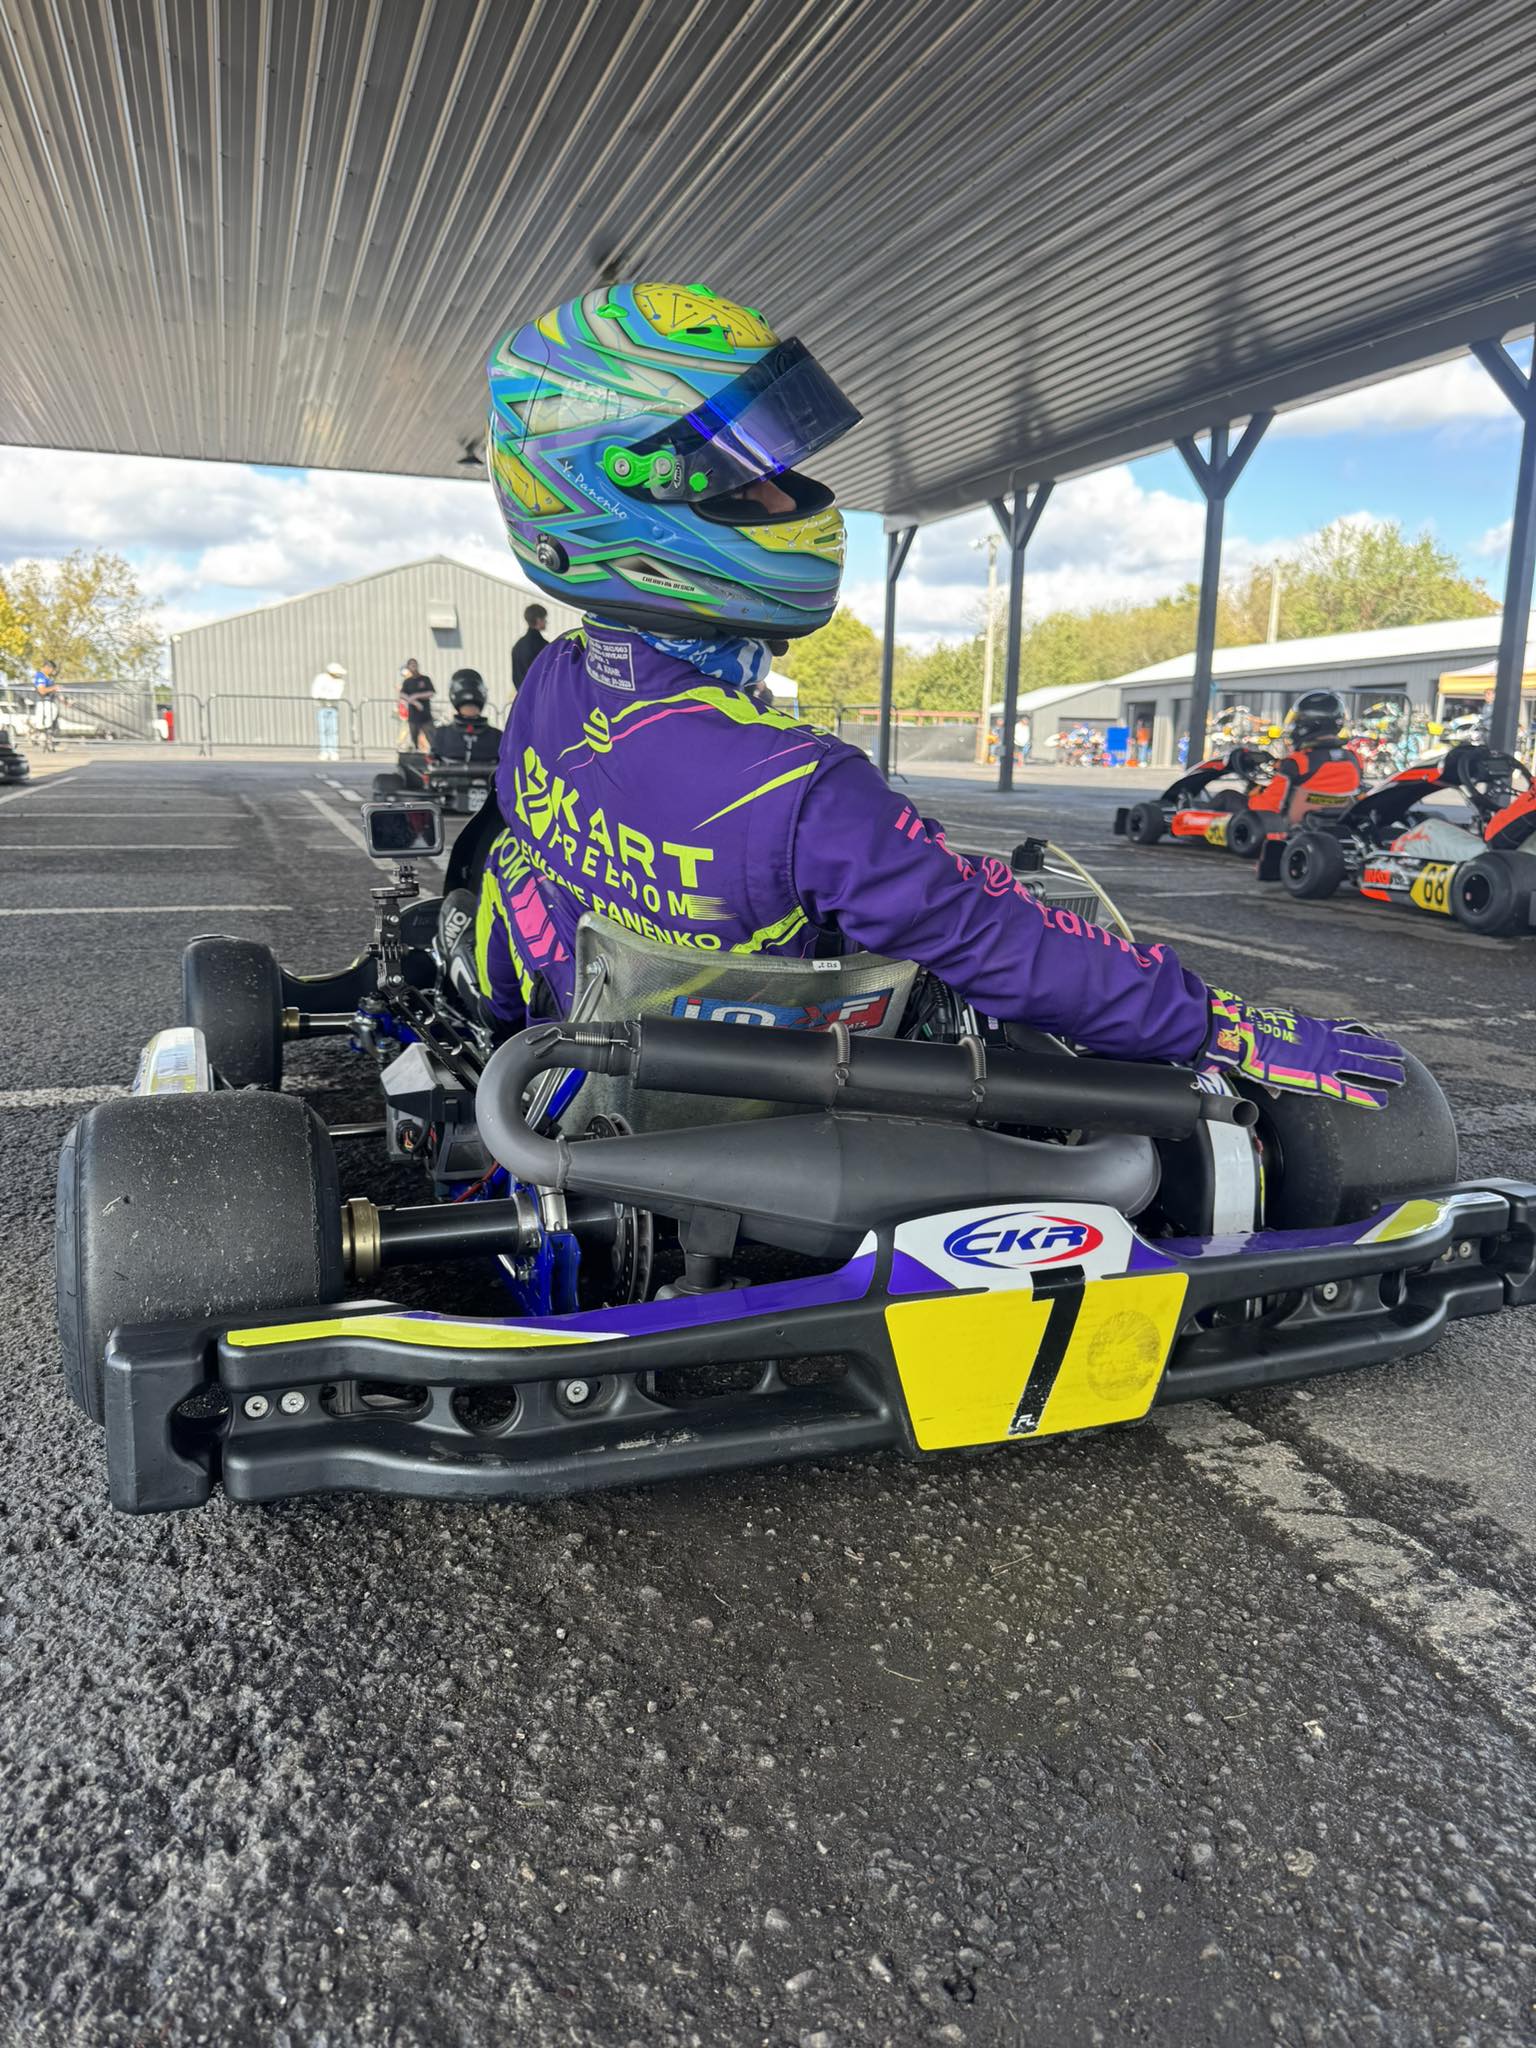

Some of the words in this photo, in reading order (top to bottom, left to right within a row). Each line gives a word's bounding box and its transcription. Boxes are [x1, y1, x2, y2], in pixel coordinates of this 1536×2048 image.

[575, 473, 627, 519] Panenko
[673, 583, 695, 592] DESIGN
[551, 776, 714, 888] KART
[548, 824, 695, 919] FREEDOM
[592, 893, 722, 951] PANENKO
[951, 1224, 1088, 1257] CKR
[1009, 1264, 1086, 1435] 7
